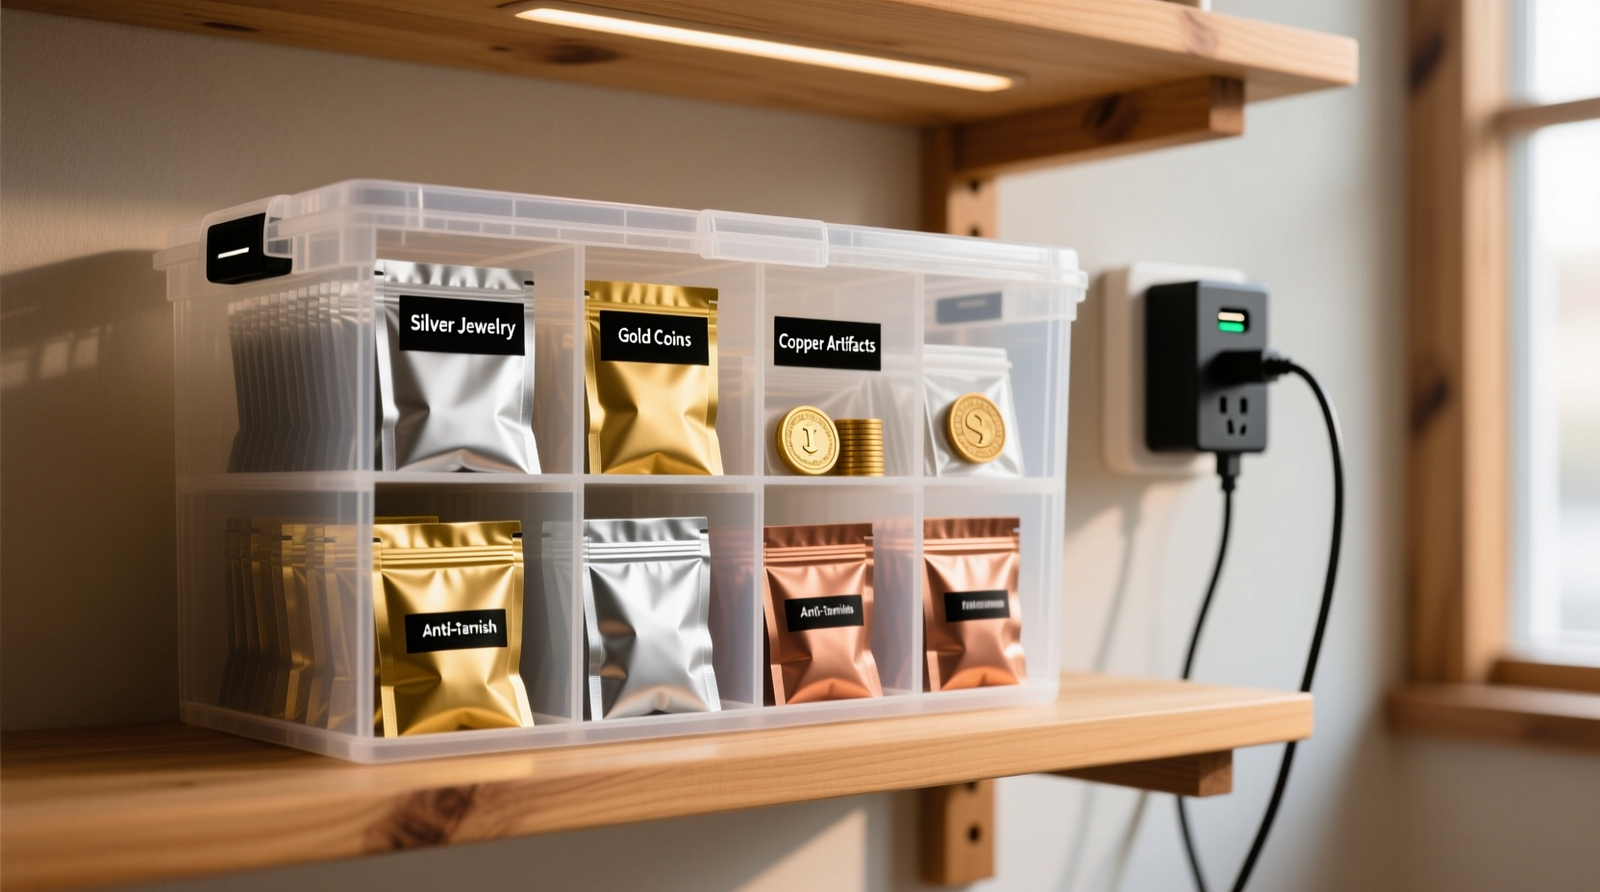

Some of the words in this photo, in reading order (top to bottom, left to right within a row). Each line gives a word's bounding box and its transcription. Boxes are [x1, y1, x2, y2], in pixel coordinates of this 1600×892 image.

[410, 313, 455, 333] Silver
[457, 316, 516, 340] Jewelry
[618, 327, 651, 344] Gold
[654, 329, 692, 347] Coins
[778, 333, 824, 354] Copper
[826, 335, 876, 353] Artifacts
